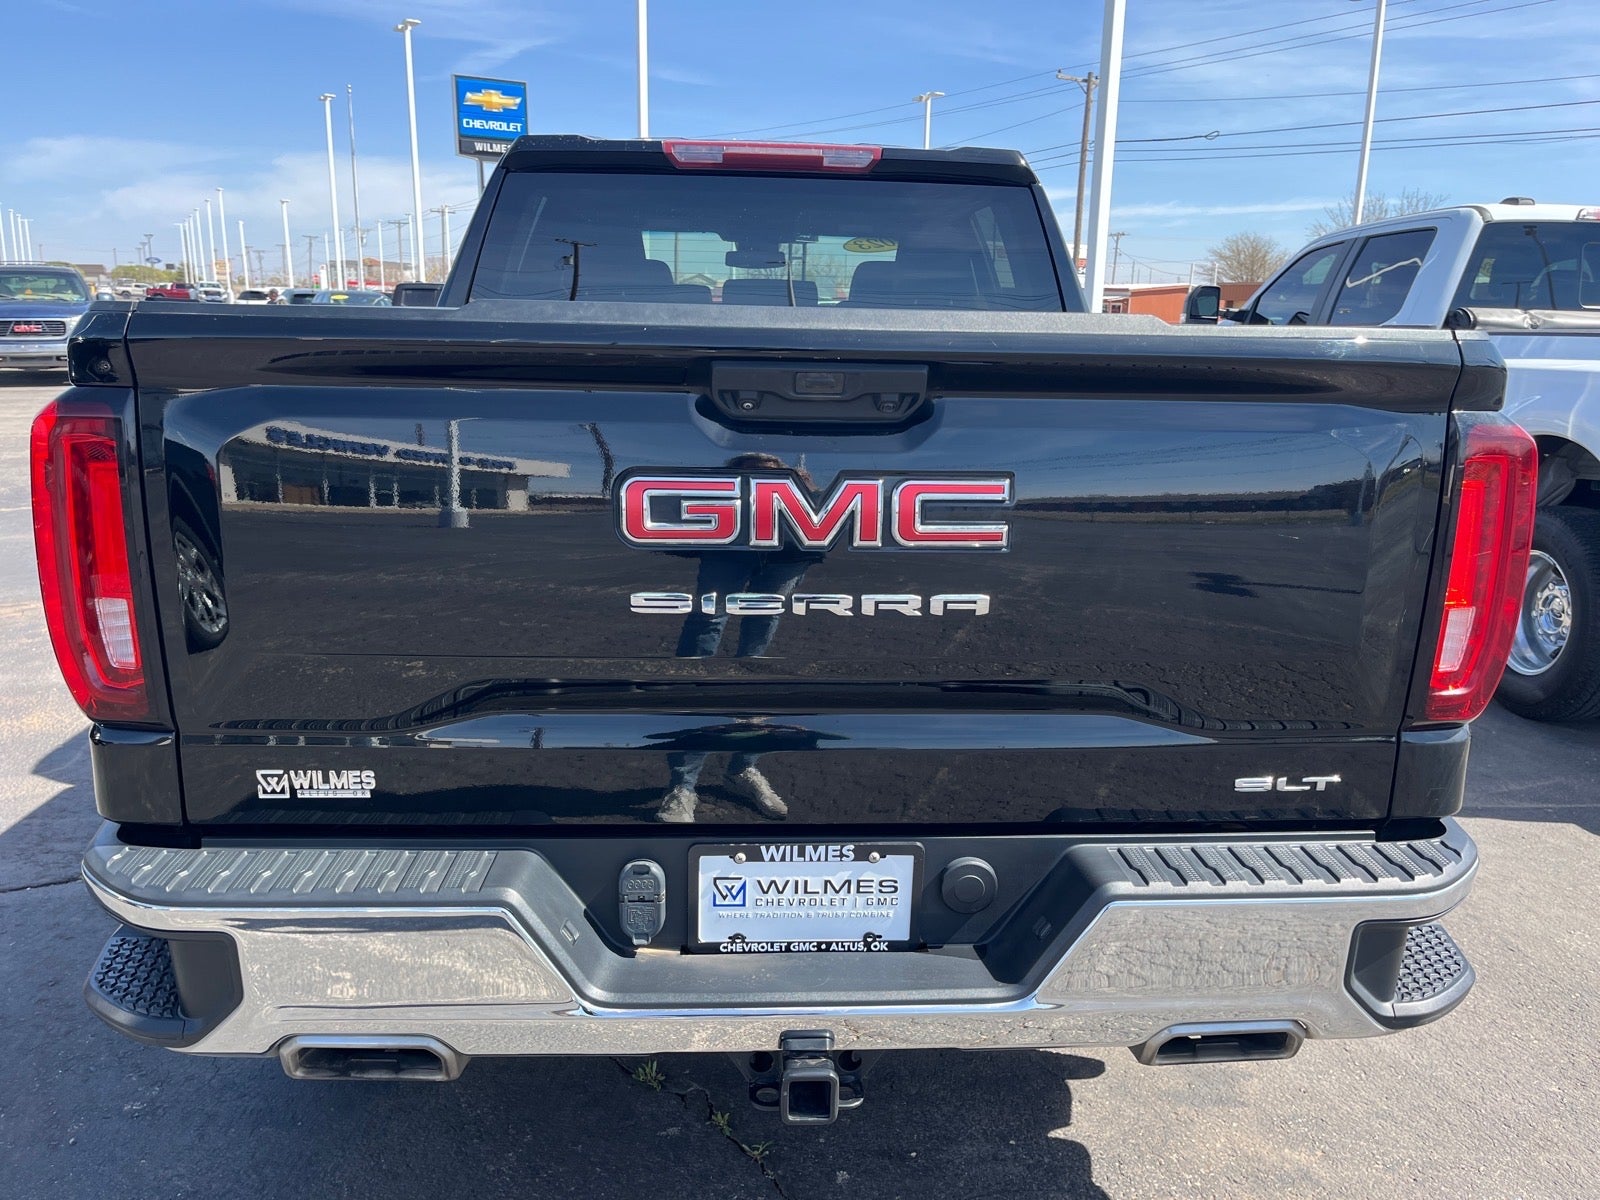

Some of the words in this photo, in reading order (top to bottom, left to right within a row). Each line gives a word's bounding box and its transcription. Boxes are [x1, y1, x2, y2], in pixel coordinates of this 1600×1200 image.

[463, 118, 522, 132] CHEVROLET
[620, 475, 1011, 548] GMC
[630, 591, 990, 617] SIERRA
[289, 770, 376, 789] WILMES
[1234, 775, 1341, 792] SLT
[760, 845, 855, 862] WILMES
[757, 879, 899, 895] WILMES
[755, 897, 847, 907] CHEVROLET
[866, 897, 899, 906] GMC
[817, 911, 846, 919] TRUST
[849, 911, 892, 919] COMBINE
[720, 942, 787, 952] CHEVROLET
[790, 942, 818, 952] GMC
[829, 941, 867, 952] ALTUS,
[870, 941, 889, 952] OK
